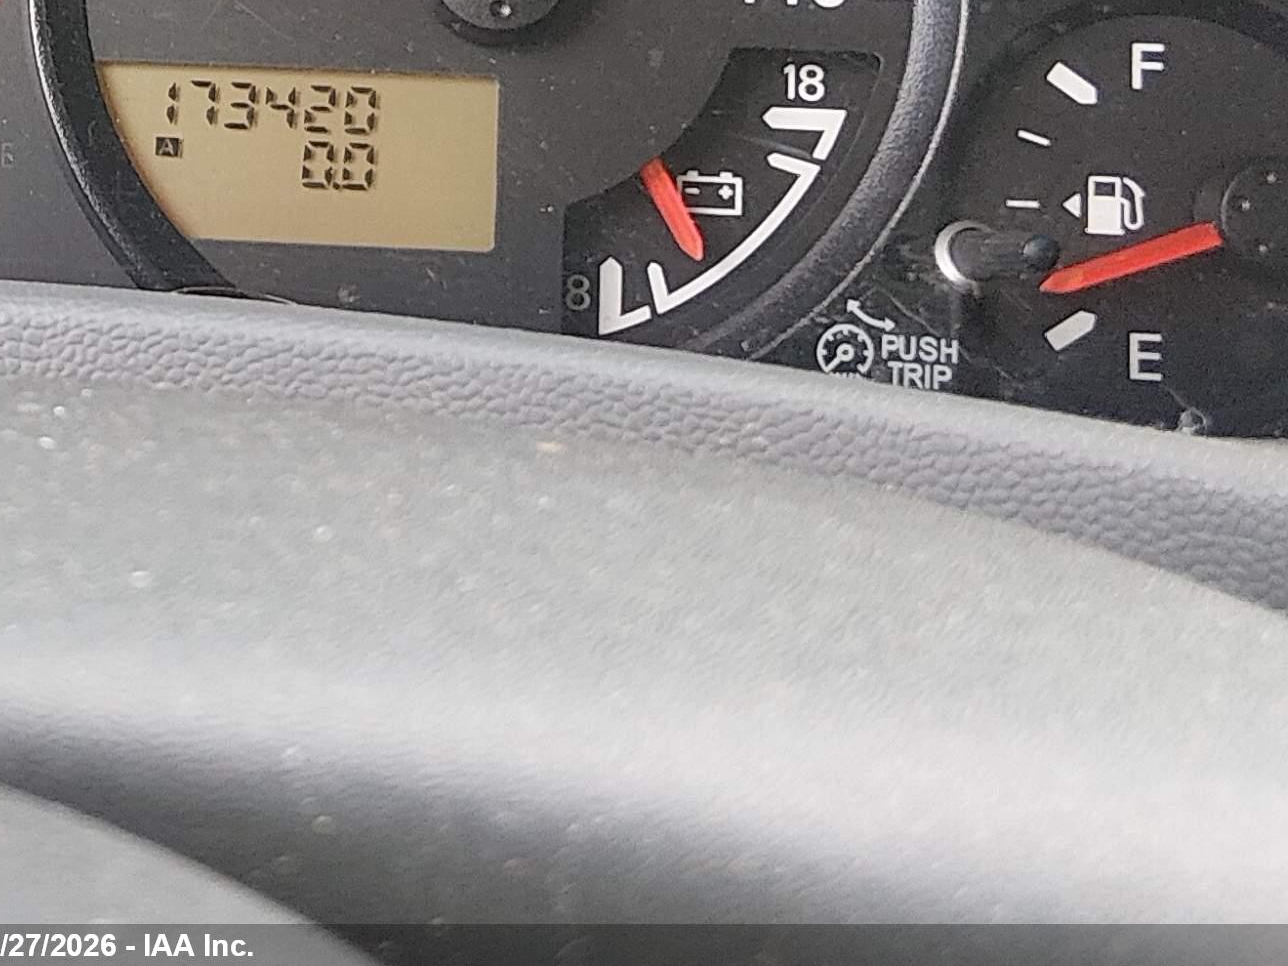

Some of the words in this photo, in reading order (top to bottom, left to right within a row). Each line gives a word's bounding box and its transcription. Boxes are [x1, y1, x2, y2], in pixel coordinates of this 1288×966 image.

[783, 64, 826, 102] 18
[1130, 42, 1165, 90] F
[168, 79, 378, 134] 173420
[159, 137, 178, 157] A
[302, 140, 376, 191] 0.0
[565, 274, 592, 312] 8
[881, 335, 959, 366] PUSH
[1128, 332, 1163, 381] E
[887, 361, 953, 390] TRIP
